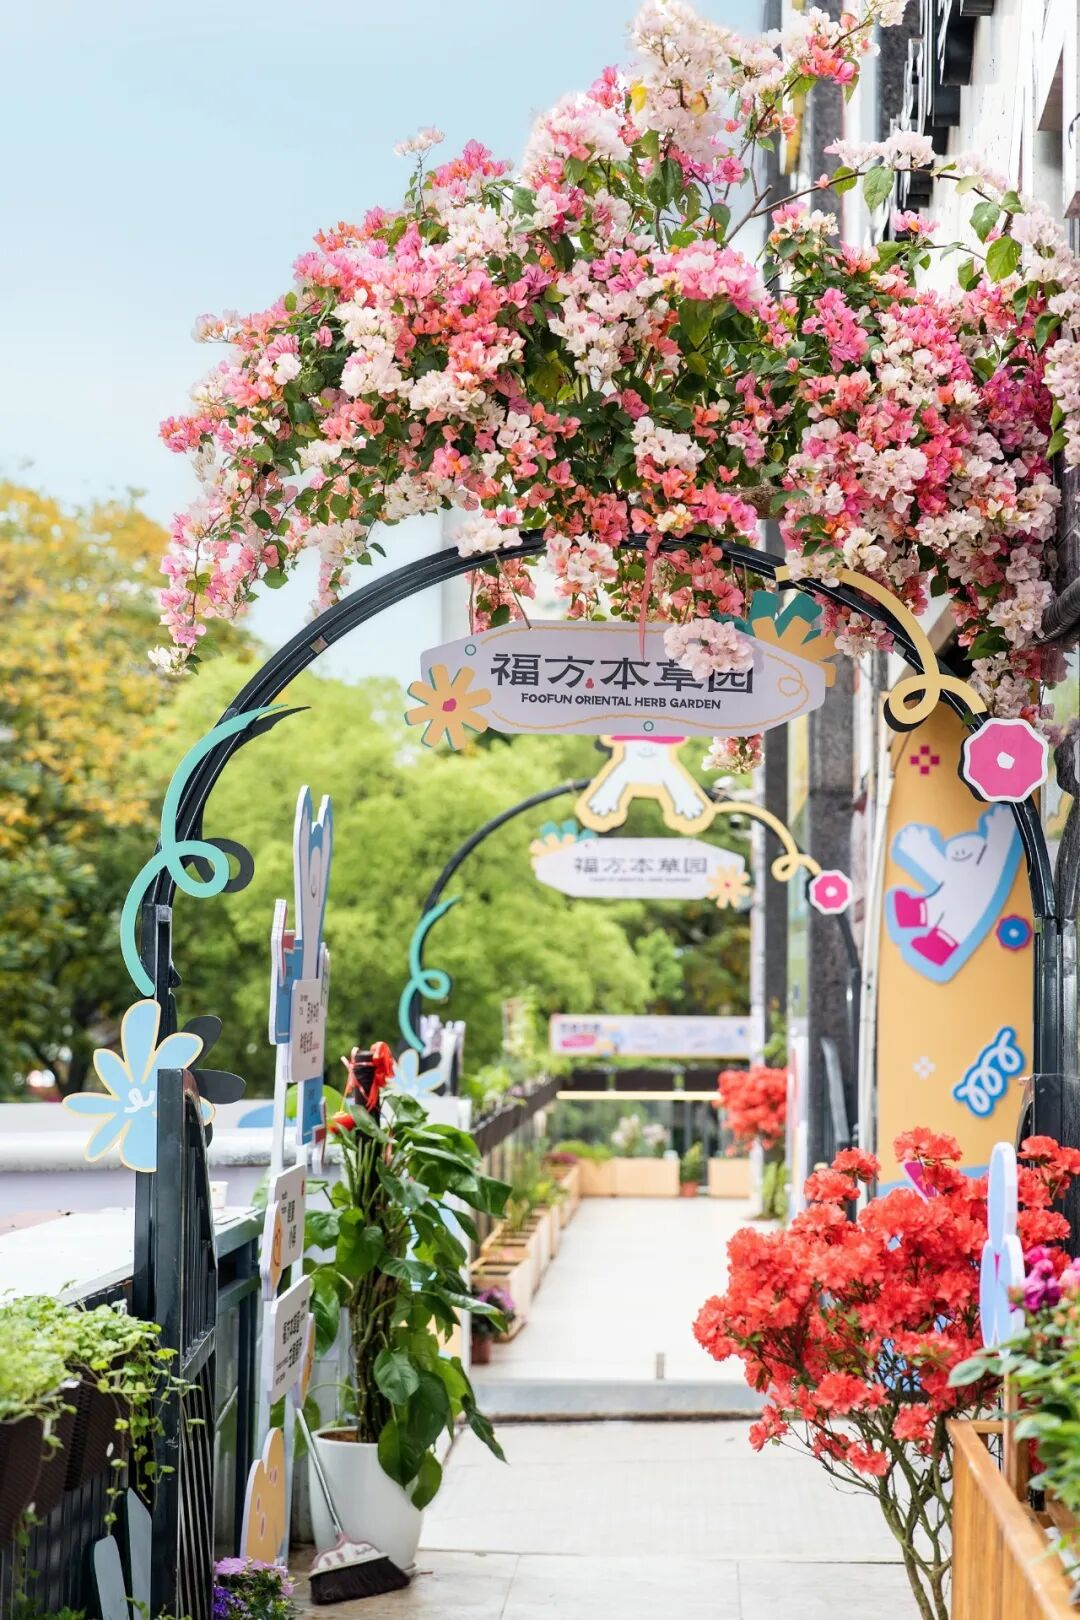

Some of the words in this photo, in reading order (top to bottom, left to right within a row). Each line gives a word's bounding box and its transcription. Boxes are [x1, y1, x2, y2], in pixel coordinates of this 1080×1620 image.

[490, 653, 754, 694] 福方本草园
[521, 693, 572, 704] FOOFUN
[575, 695, 631, 706] ORIENTAL
[634, 697, 667, 708] HERB
[669, 698, 721, 709] GARDEN
[574, 857, 707, 874] 福方本草园
